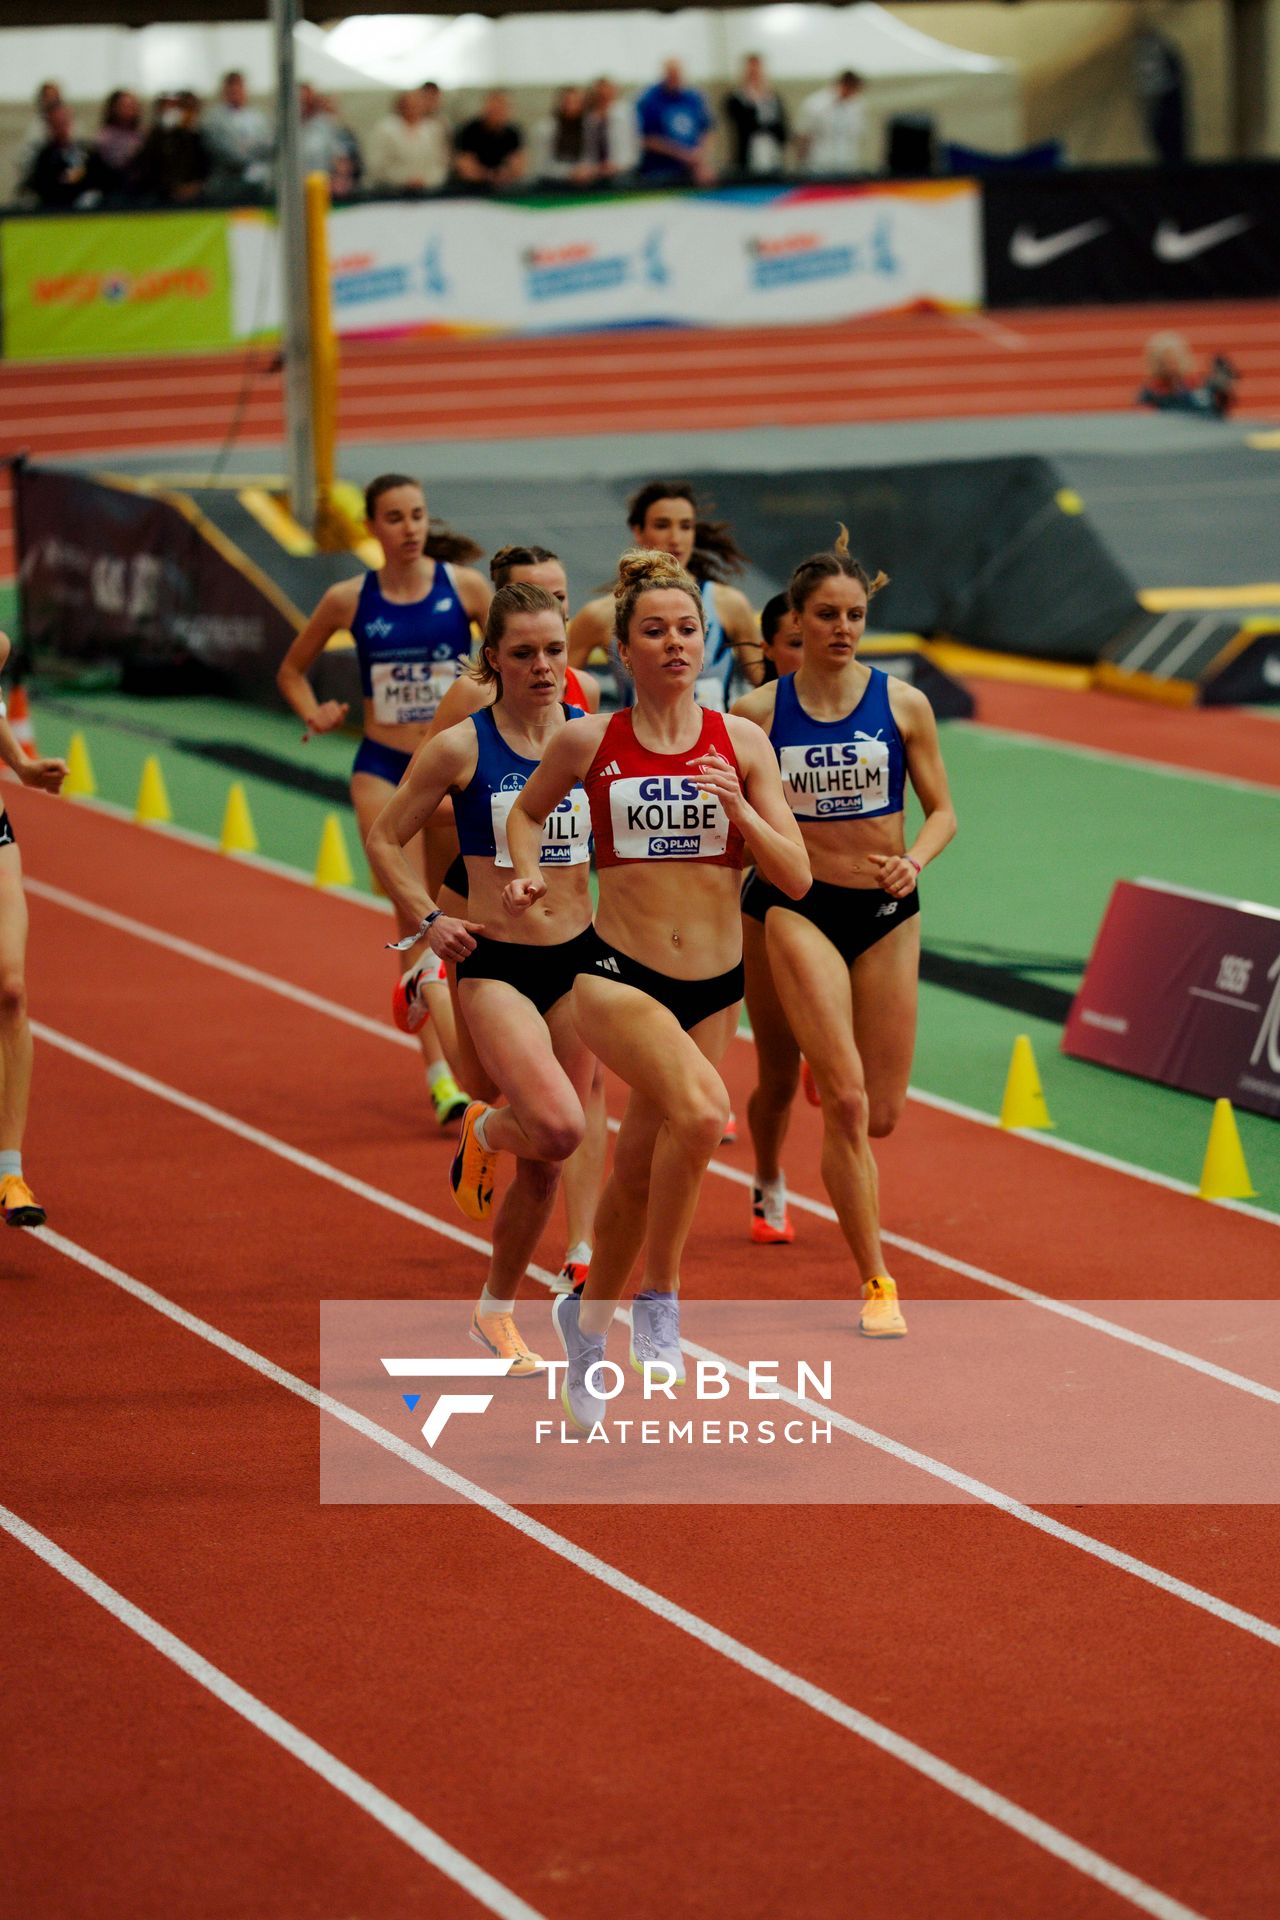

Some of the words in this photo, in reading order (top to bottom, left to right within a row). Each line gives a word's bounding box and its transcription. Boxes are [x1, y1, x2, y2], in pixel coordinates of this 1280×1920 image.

[788, 766, 881, 794] WILHELM
[835, 797, 861, 807] PLAN
[543, 815, 580, 840] ILL
[627, 804, 717, 830] KOLBE
[670, 839, 699, 849] PLAN
